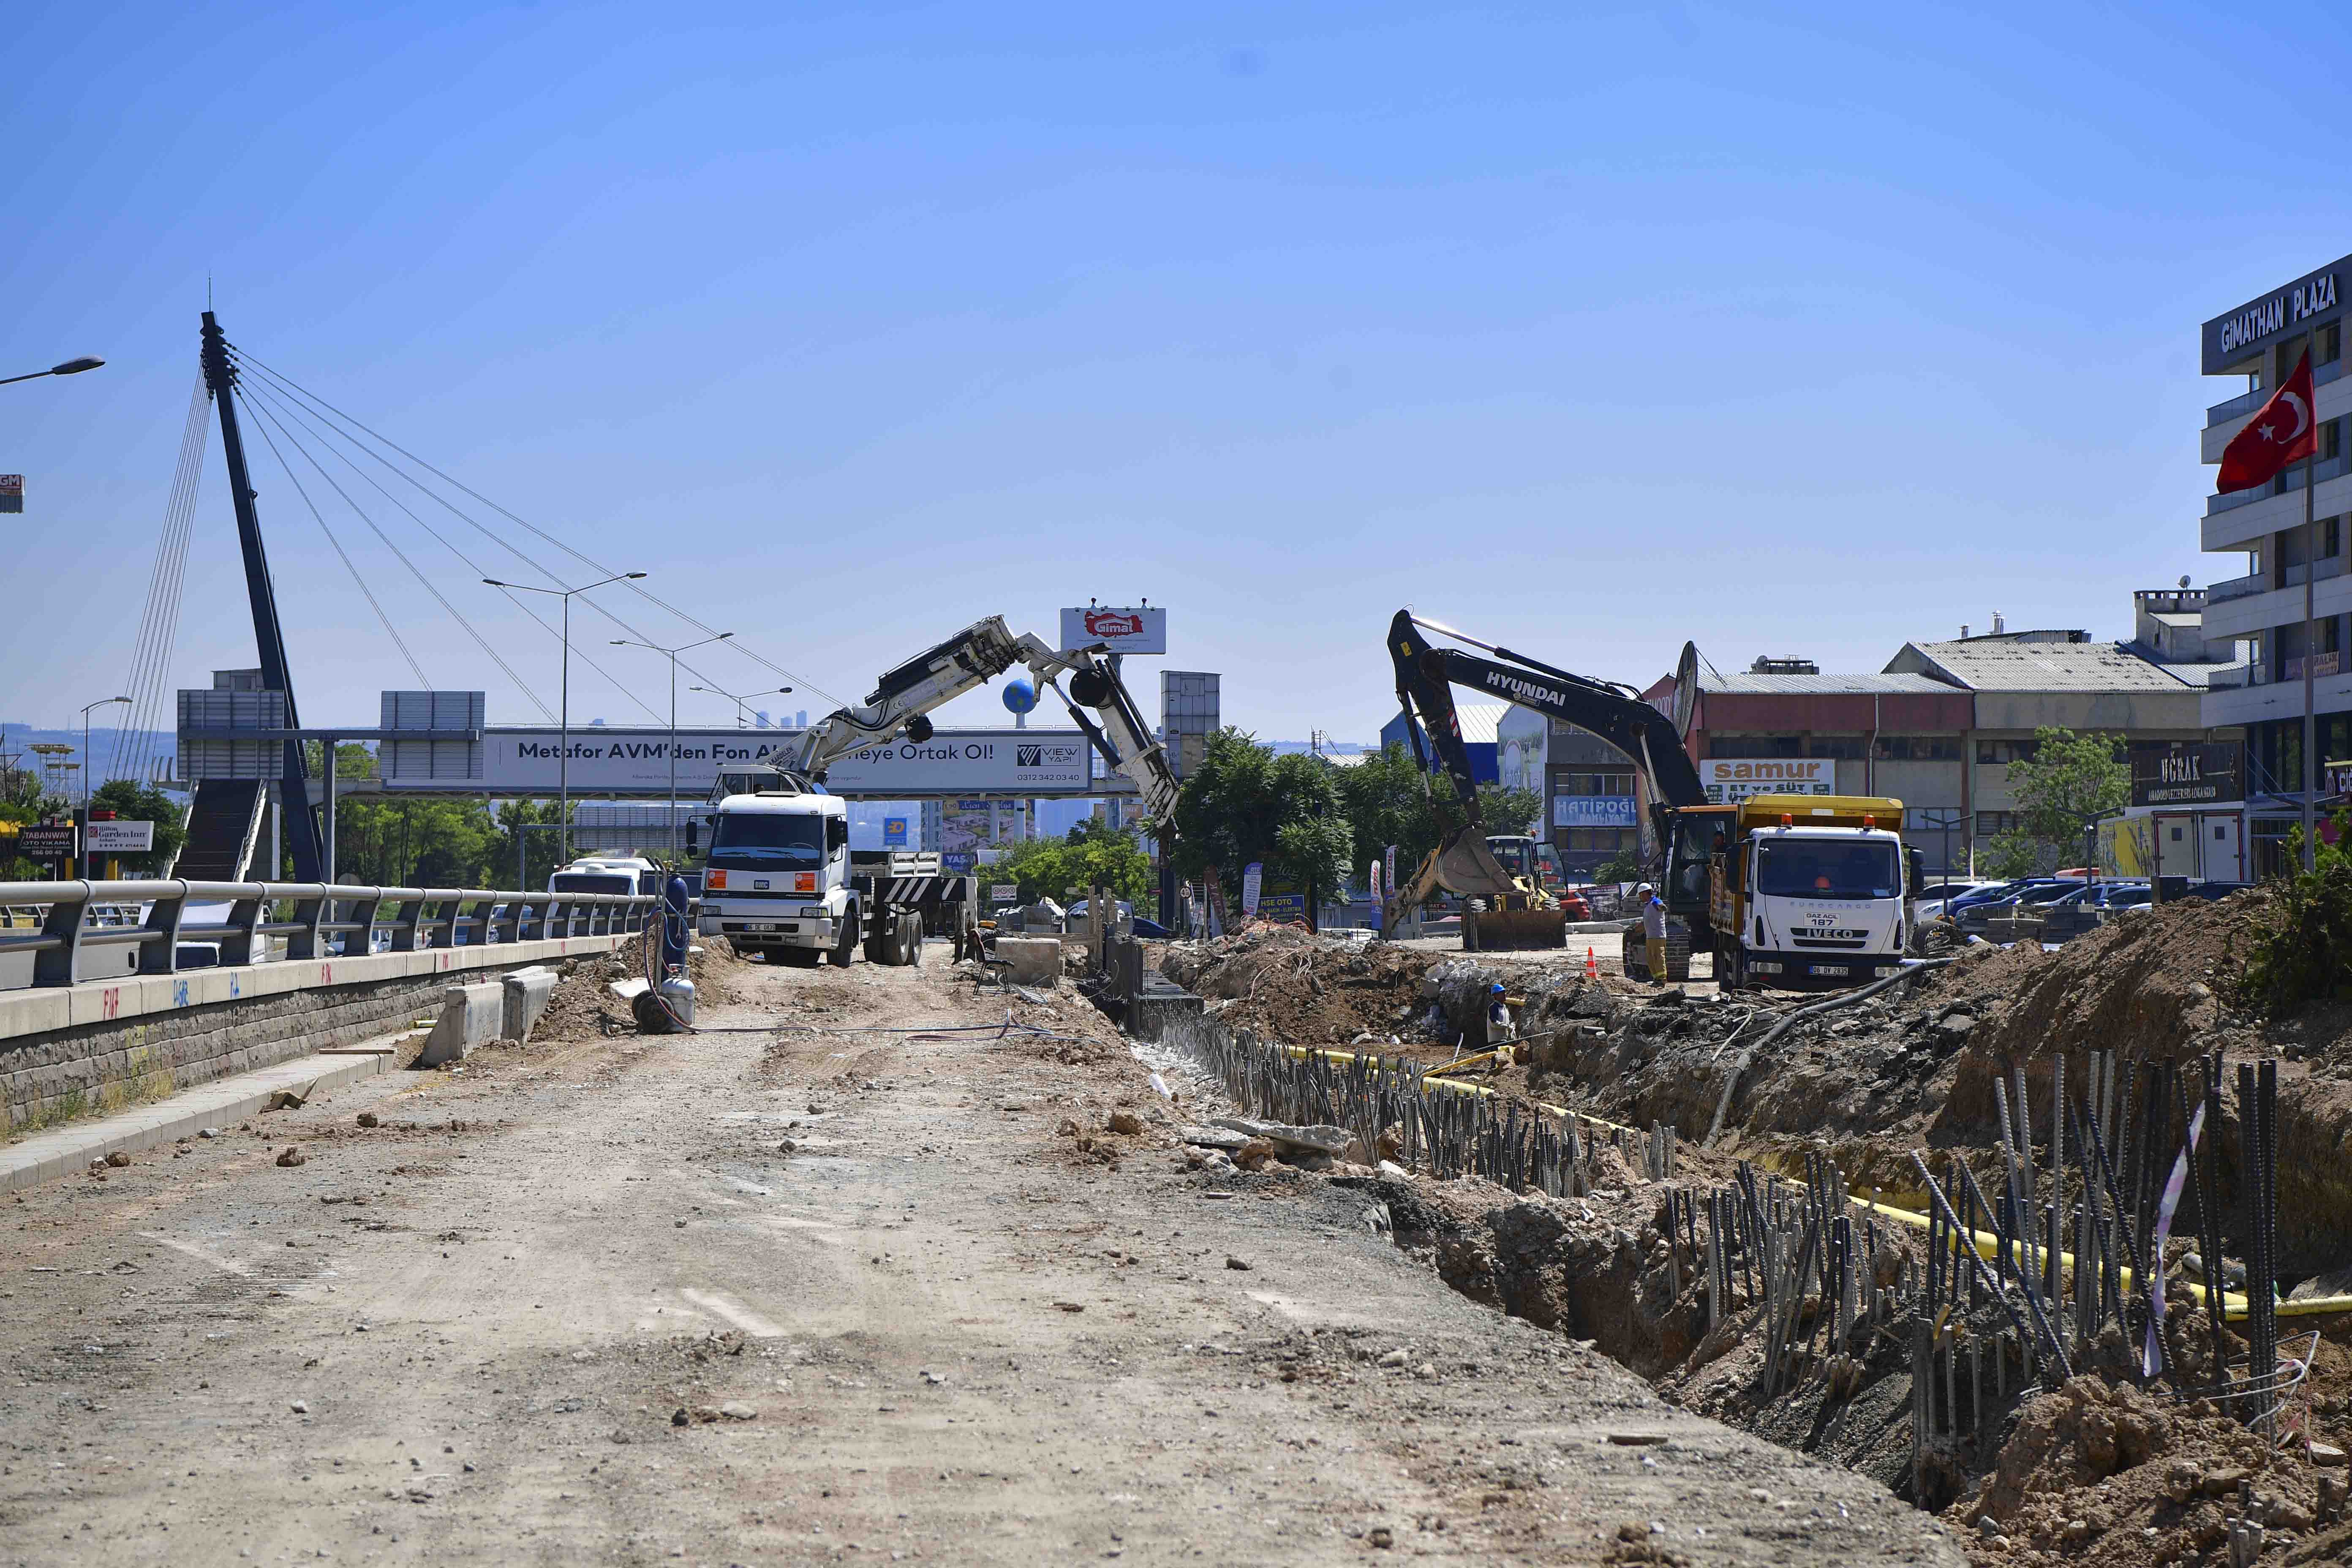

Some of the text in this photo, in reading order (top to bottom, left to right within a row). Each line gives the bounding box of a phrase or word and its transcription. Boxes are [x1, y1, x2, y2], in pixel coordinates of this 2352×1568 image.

[2294, 274, 2336, 321] PLAZA
[1486, 672, 1566, 706] HYUNDAI
[518, 742, 603, 759] Metafor
[608, 743, 706, 759] AVM'den
[712, 744, 749, 759] Fon
[900, 745, 959, 760] Ortak
[965, 744, 994, 760] Ol!
[1715, 763, 1821, 778] samur
[2161, 750, 2200, 783] UĞRAK
[1775, 782, 1805, 792] SÜT
[1806, 929, 1854, 939] IVECO
